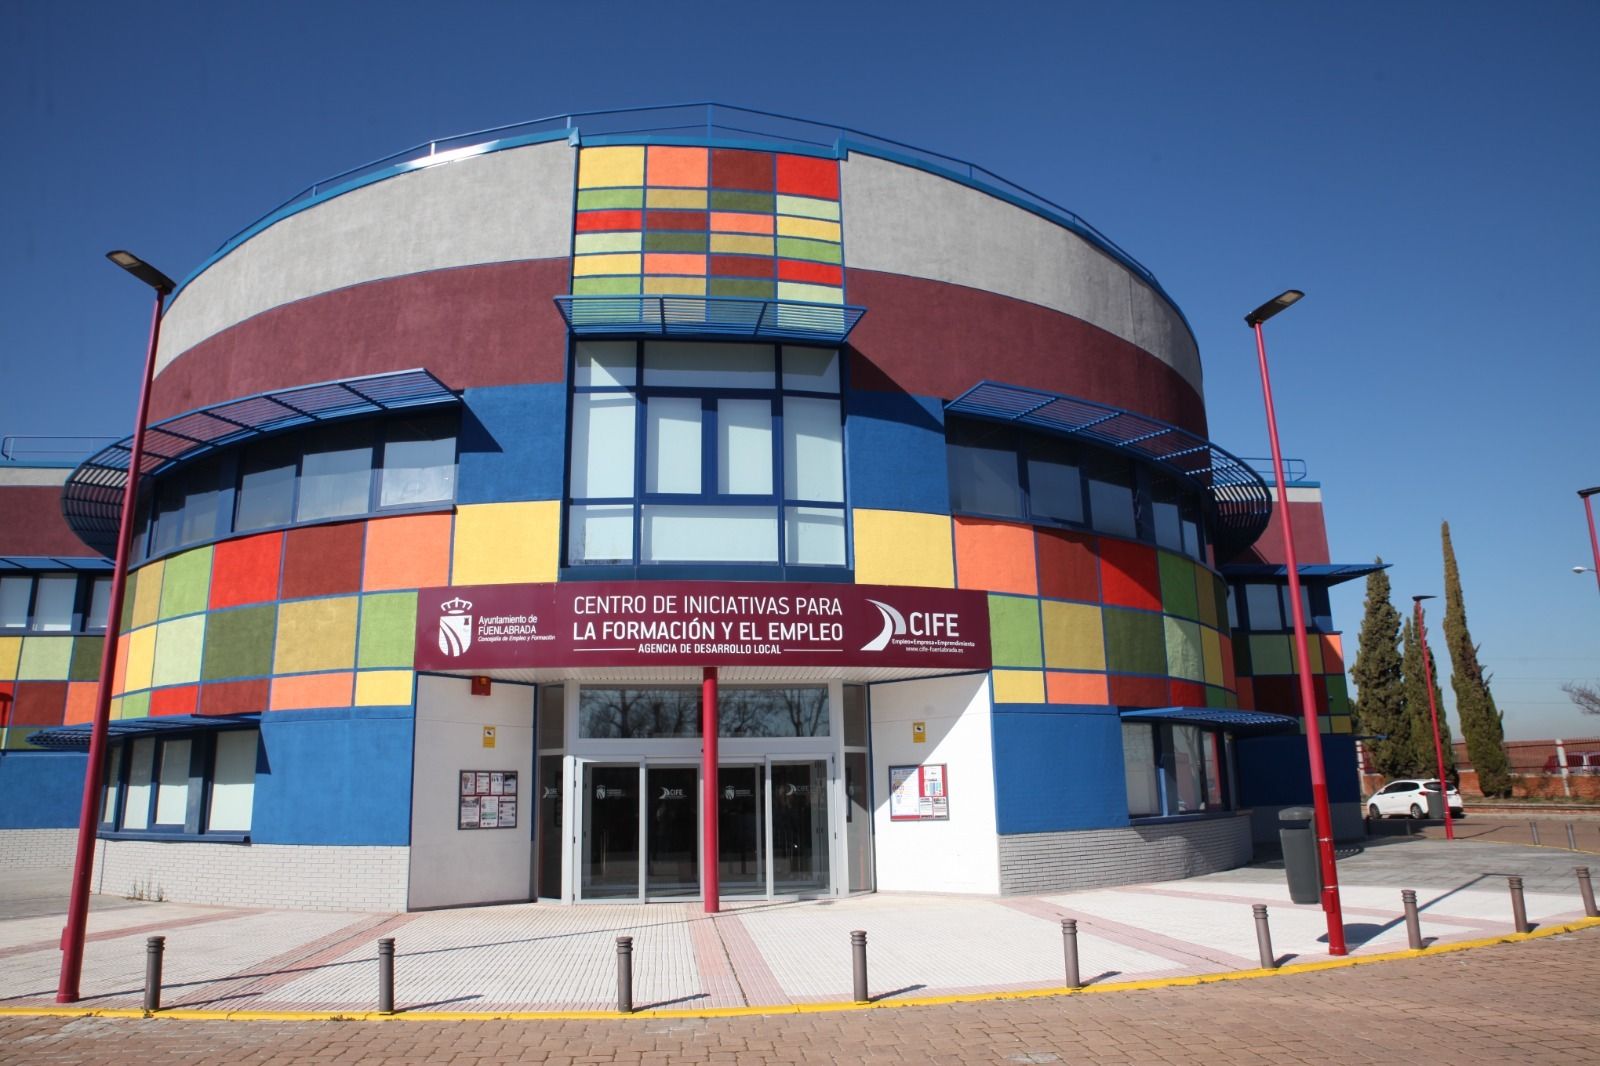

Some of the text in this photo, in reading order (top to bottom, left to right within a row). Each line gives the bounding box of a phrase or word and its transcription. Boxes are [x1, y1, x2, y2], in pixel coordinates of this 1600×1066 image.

[574, 595, 843, 616] CENTRO DE INICIATIVAS PARA
[478, 614, 538, 626] Ayuntamiento de
[909, 611, 960, 637] CIFE
[478, 625, 537, 636] FUENLABRADA
[573, 617, 843, 641] LA FORMACIÓN Y EL EMPLEO
[638, 643, 782, 654] AGENCIA DE DESARROLLO LOCAL
